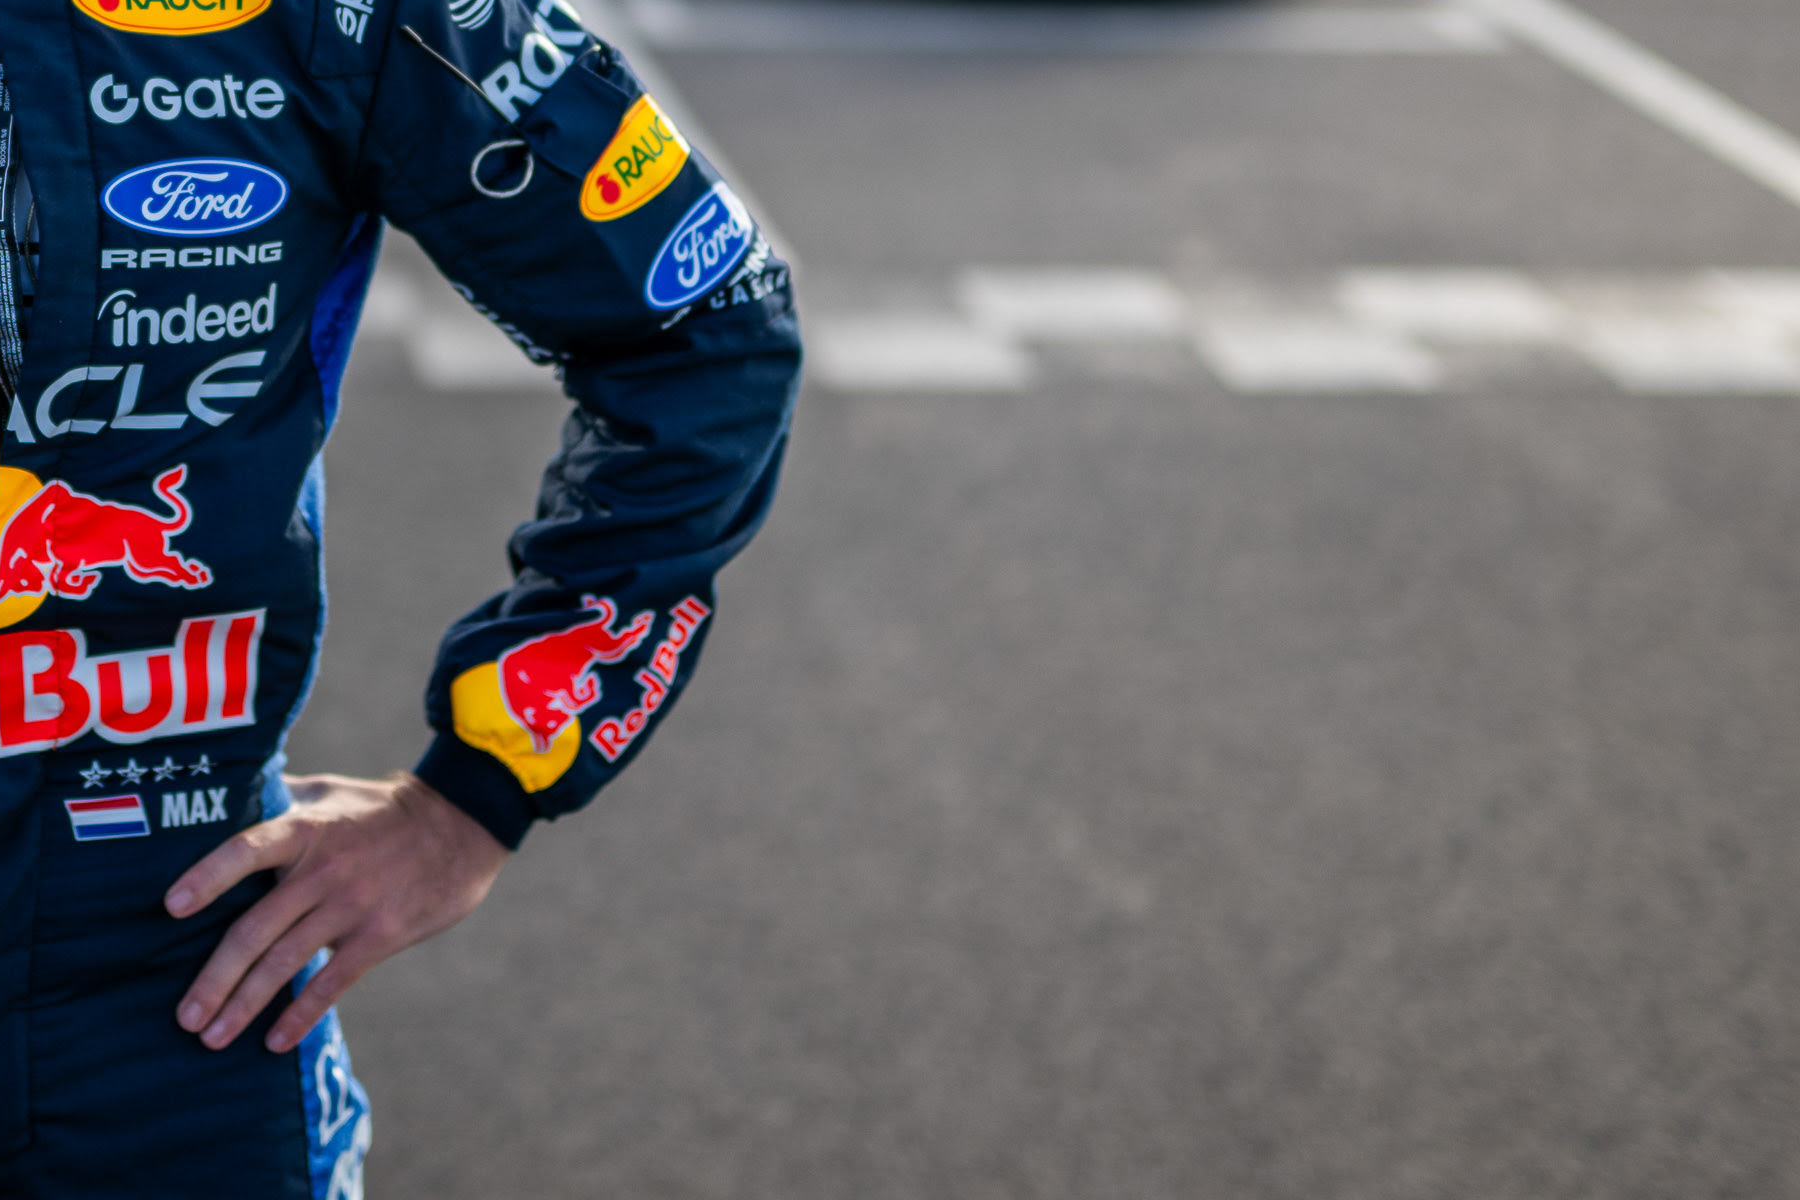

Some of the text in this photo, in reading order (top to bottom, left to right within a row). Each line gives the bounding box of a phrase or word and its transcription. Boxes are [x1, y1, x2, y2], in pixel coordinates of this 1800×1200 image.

[143, 74, 285, 120] Gate
[614, 117, 674, 188] RAUC
[141, 171, 255, 221] Ford
[101, 241, 283, 269] RACING
[111, 282, 277, 347] indeed
[589, 595, 712, 763] Red Bull
[161, 787, 228, 829] MAX
